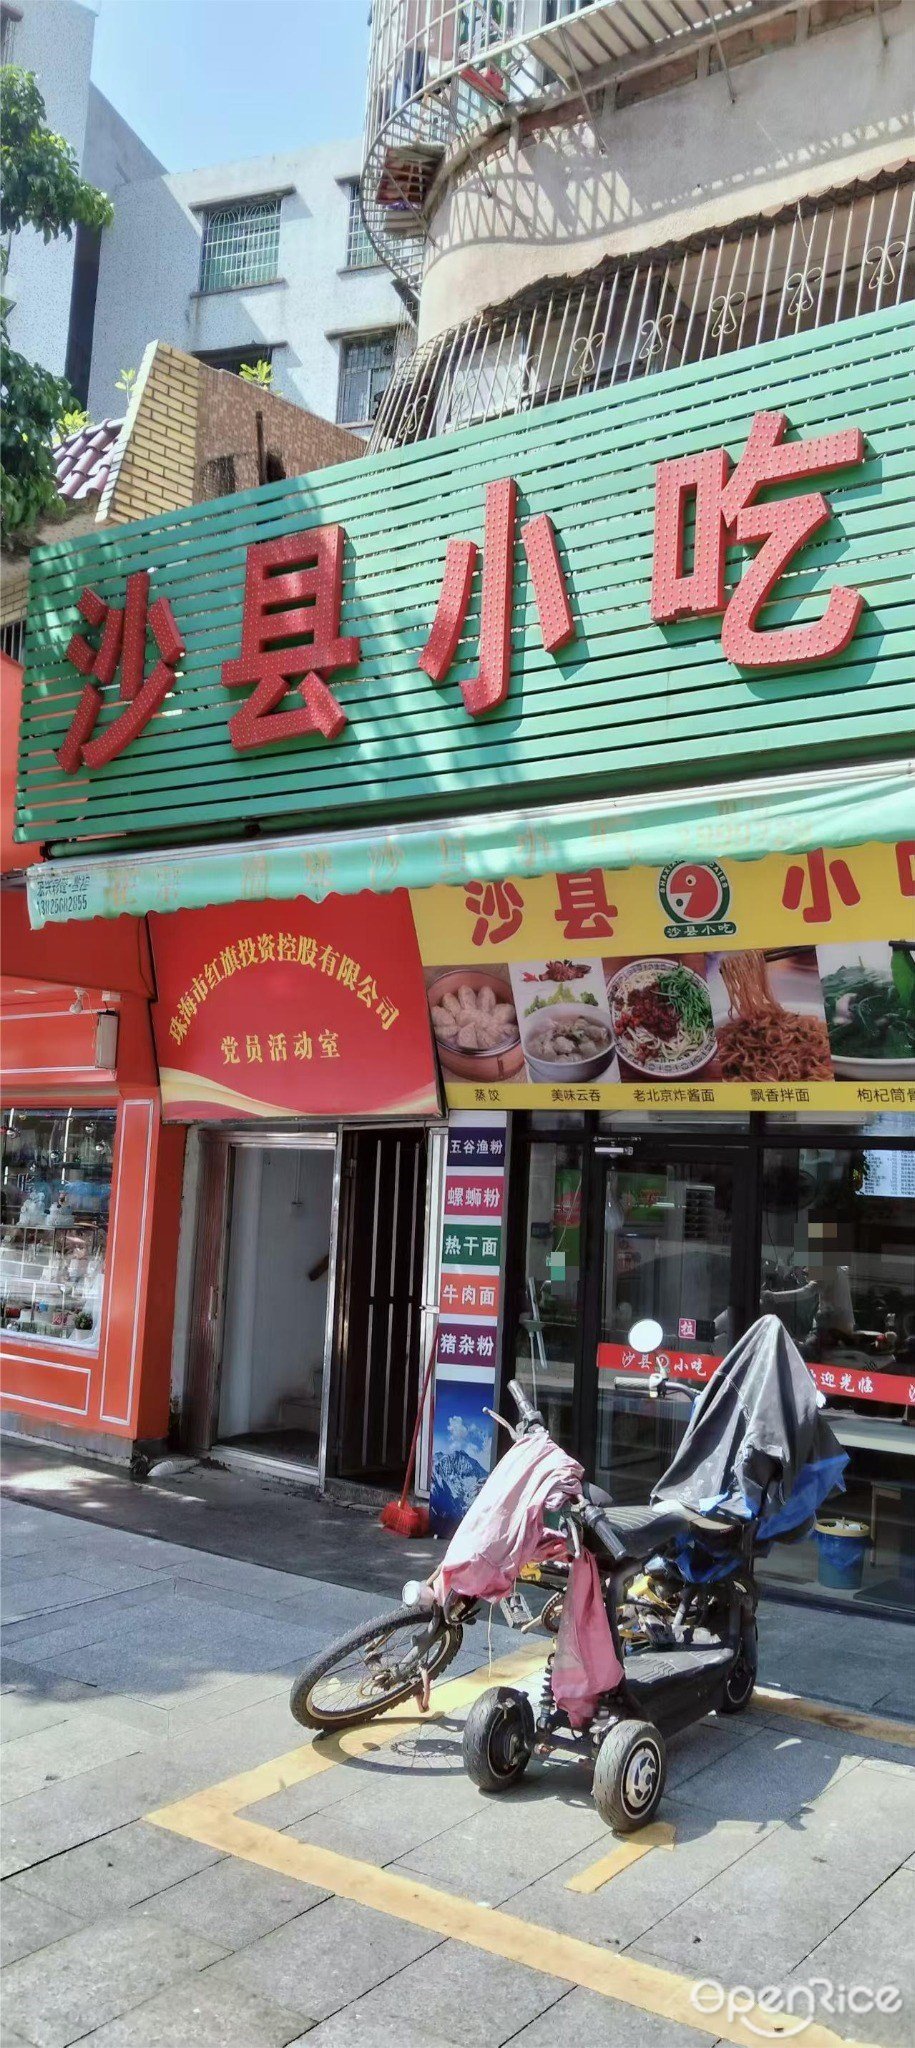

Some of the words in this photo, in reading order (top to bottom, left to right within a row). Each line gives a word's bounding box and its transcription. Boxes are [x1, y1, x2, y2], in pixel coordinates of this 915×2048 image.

[54, 411, 866, 774] 沙县小吃
[464, 867, 618, 946] 沙县
[667, 923, 734, 937] 沙县小吃
[169, 932, 400, 1045] 珠海市红旗投资控股有限公司
[221, 1029, 341, 1065] 党员活动室
[474, 1089, 500, 1102] 蒸饺
[552, 1089, 601, 1102] 美味云吞
[633, 1088, 715, 1102] 老北京炸酱面
[750, 1088, 810, 1103] 飘香拌面
[450, 1139, 503, 1155] 五谷渔粉
[447, 1187, 501, 1207] 螺蛳粉
[445, 1235, 498, 1256] 热干面
[443, 1284, 496, 1306] 牛肉面
[440, 1333, 495, 1356] 猪杂粉
[621, 1351, 653, 1370] 沙县
[674, 1358, 707, 1377] 小吃
